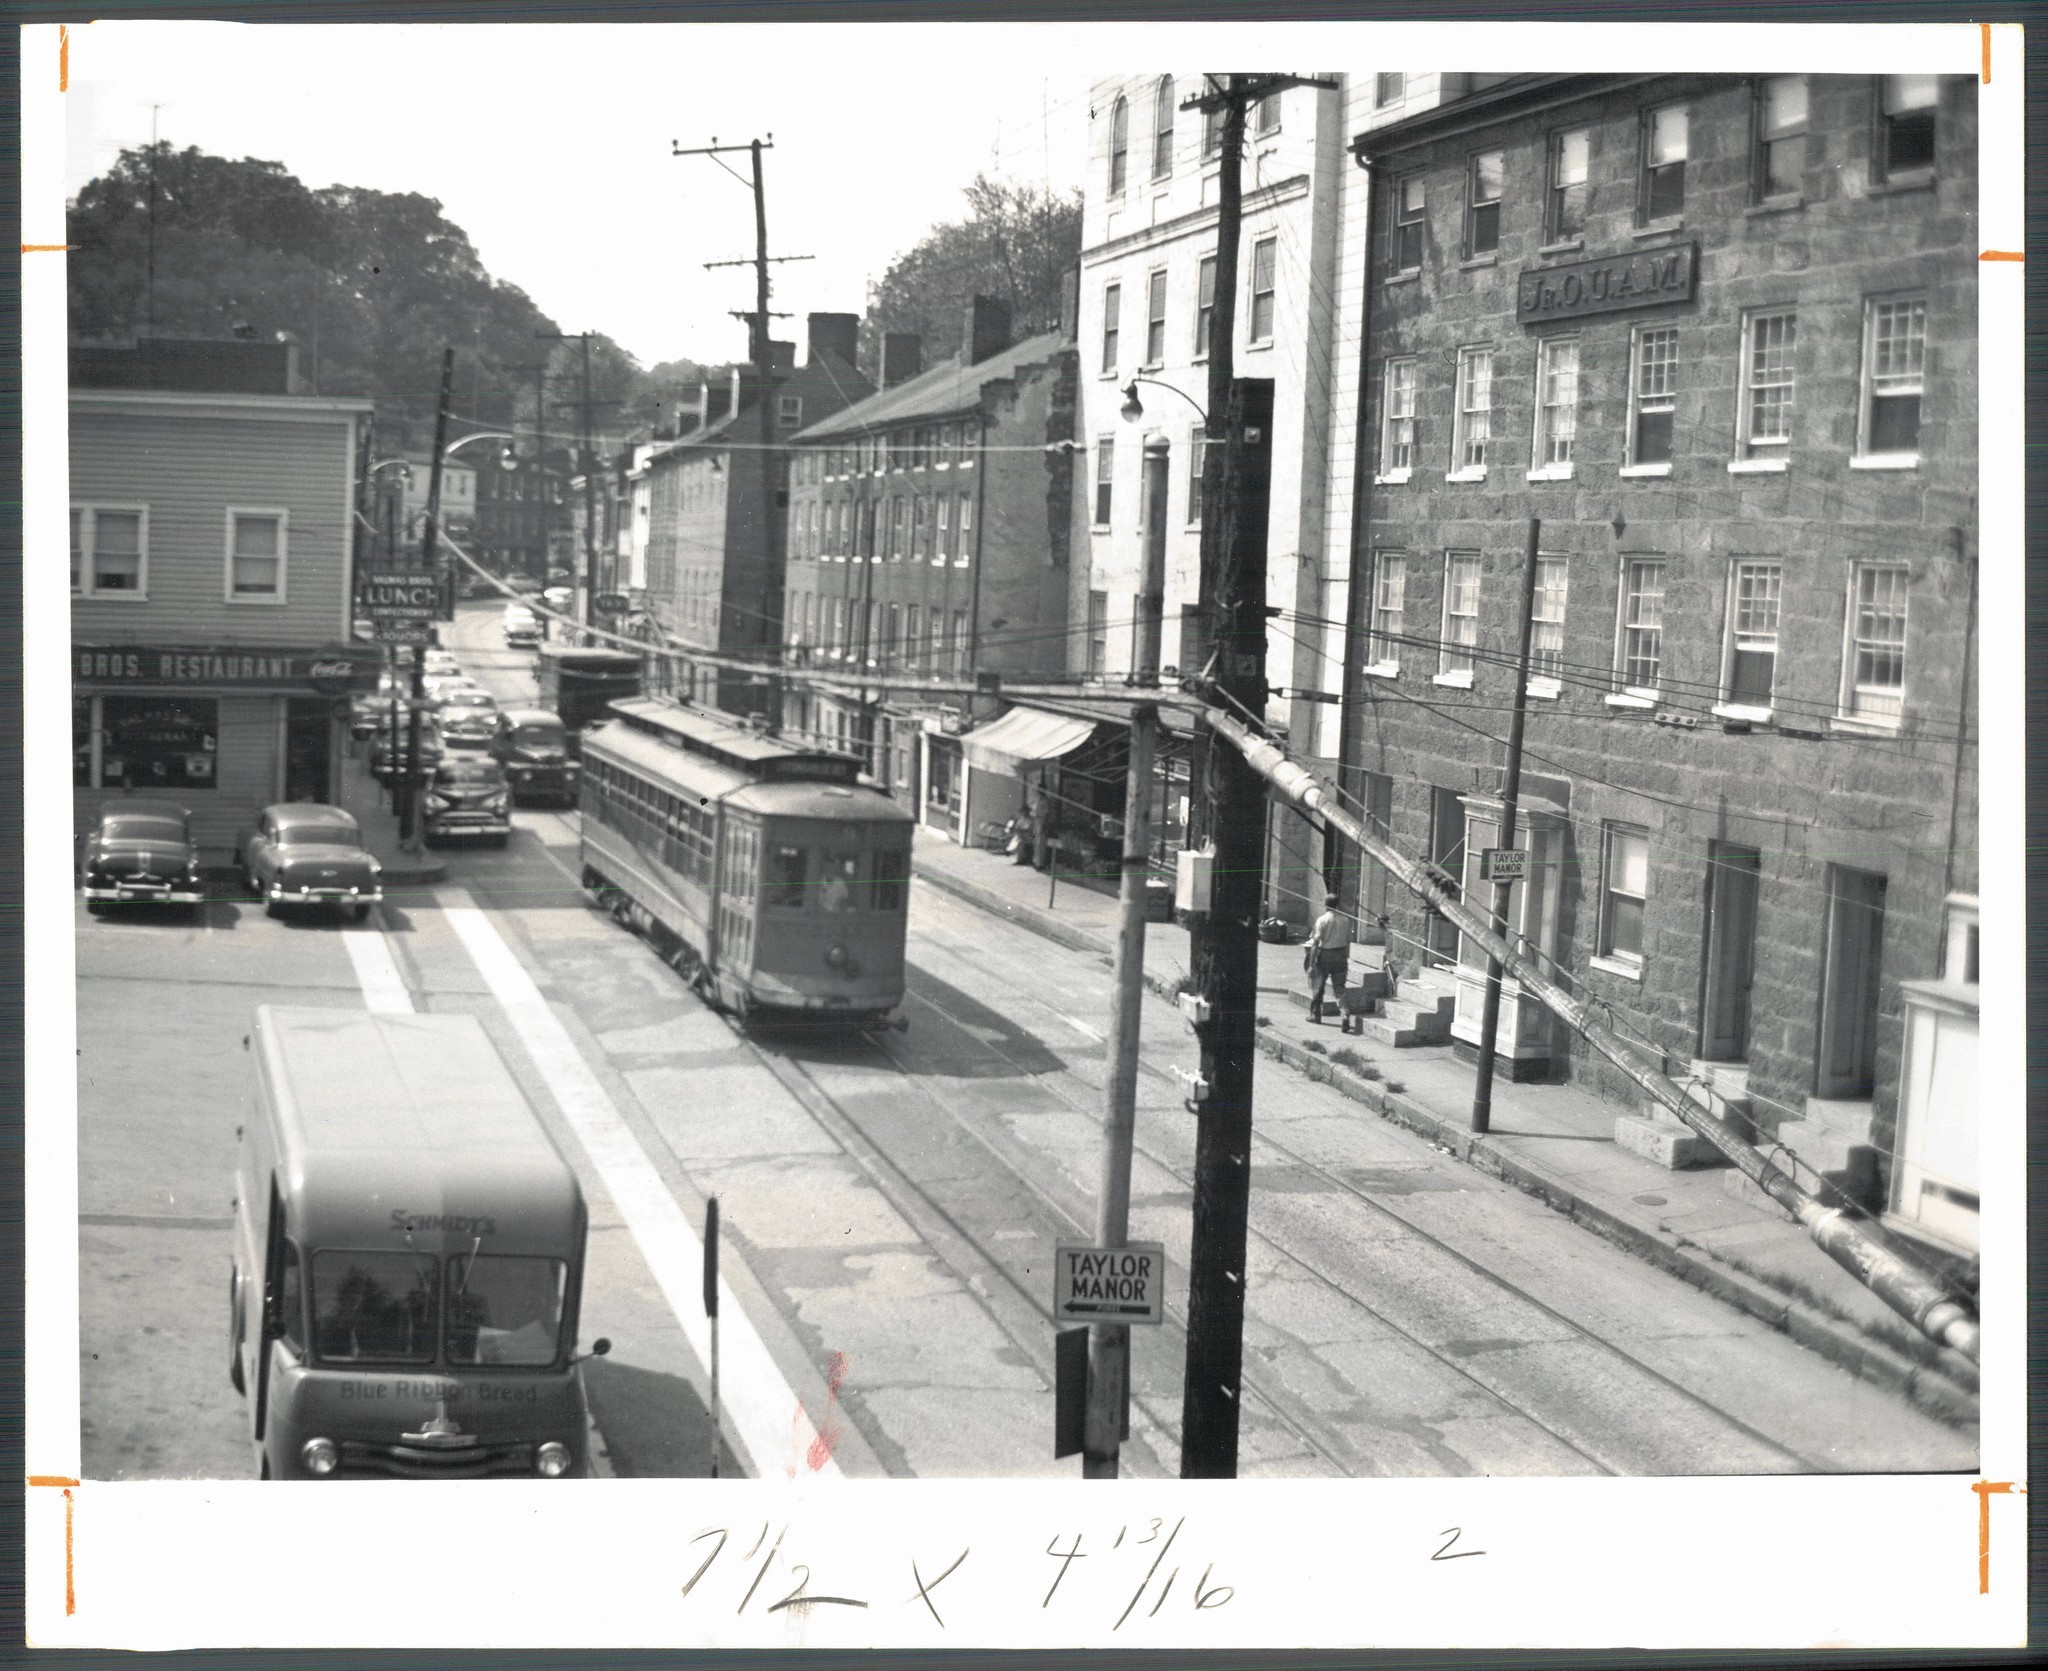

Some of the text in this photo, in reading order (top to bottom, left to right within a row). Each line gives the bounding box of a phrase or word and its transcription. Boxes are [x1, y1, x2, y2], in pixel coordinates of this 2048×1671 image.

[367, 588, 438, 605] LUNCH
[159, 654, 295, 679] RESTAURANT
[1494, 853, 1525, 863] TAYLOR
[1494, 863, 1522, 873] MANOR
[1067, 1252, 1151, 1278] TAYLOR
[1072, 1277, 1146, 1300] MANOR
[340, 1380, 538, 1402] Blue Ribbon Bread
[1430, 1526, 1487, 1561] 2
